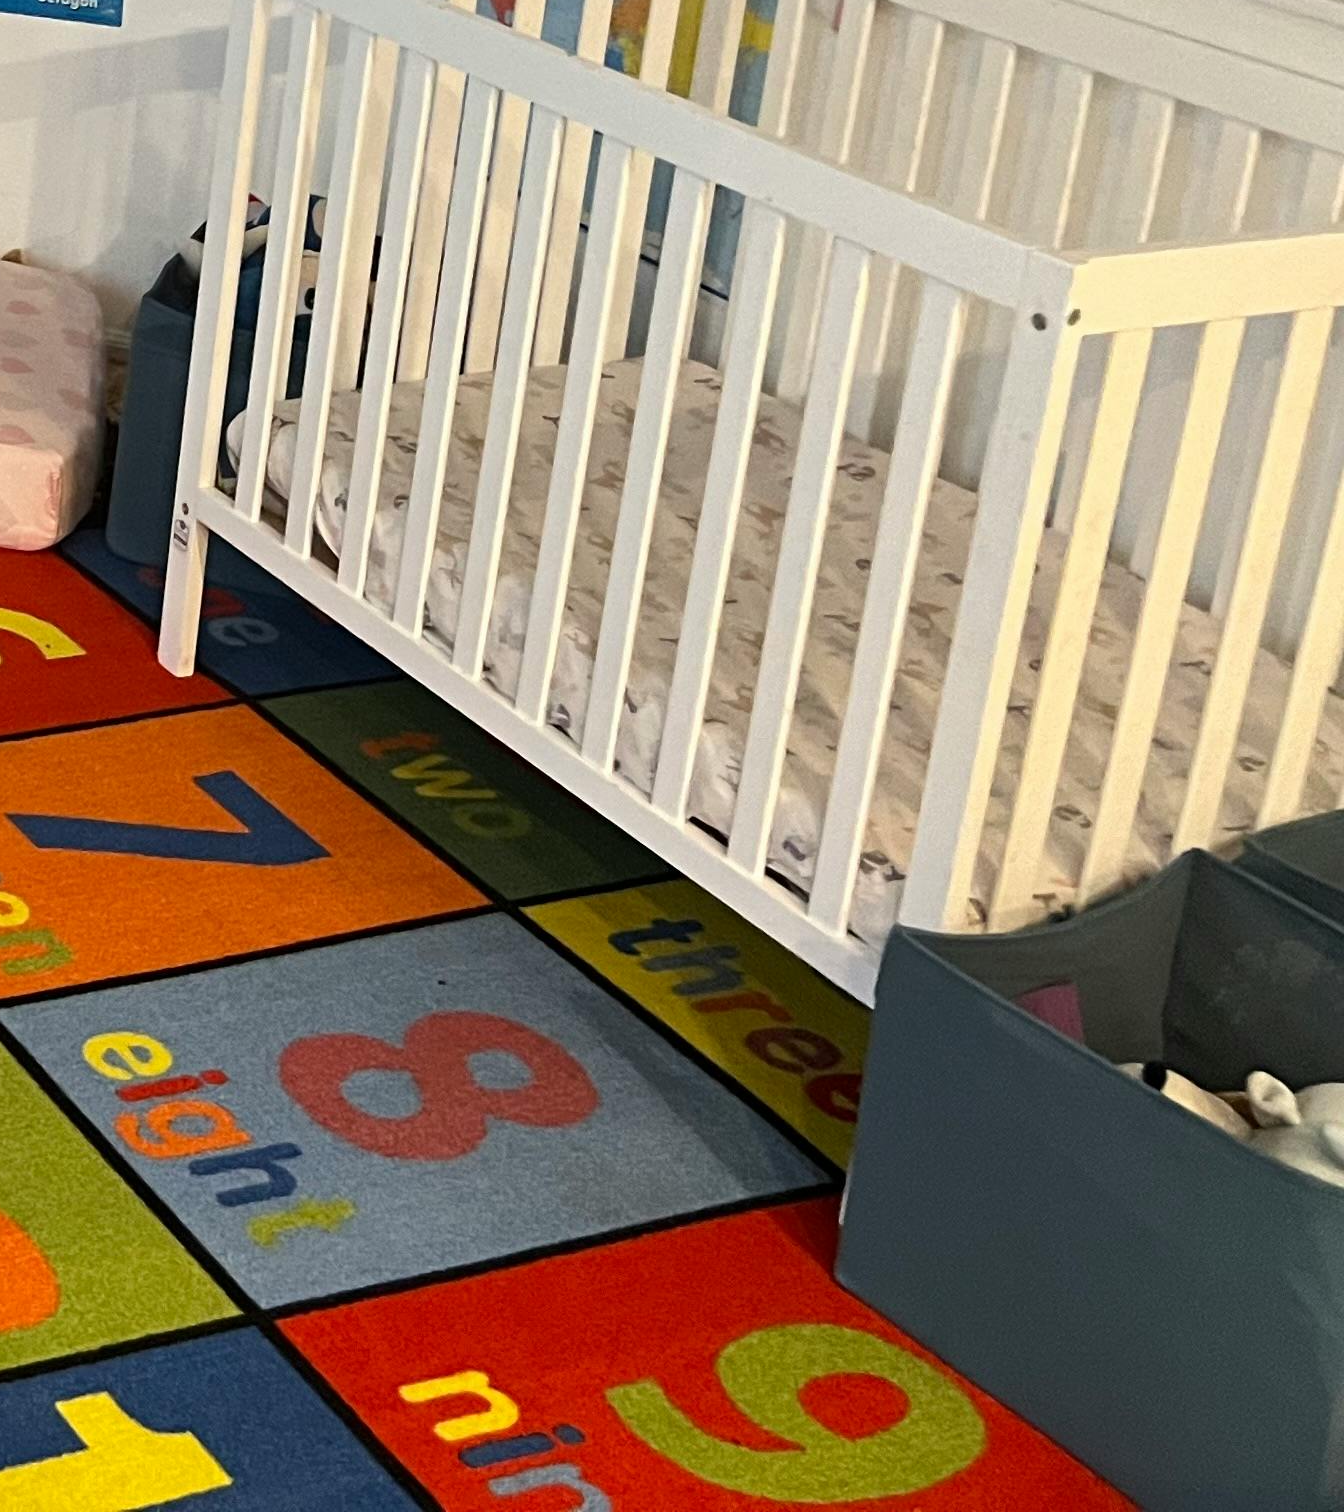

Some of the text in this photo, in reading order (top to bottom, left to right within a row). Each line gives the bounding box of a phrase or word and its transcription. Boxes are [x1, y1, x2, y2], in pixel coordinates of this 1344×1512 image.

[2, 769, 331, 867] 7
[361, 730, 532, 840] two
[82, 1031, 357, 1250] eight
[278, 1010, 600, 1161] 8
[604, 1323, 987, 1504] 9
